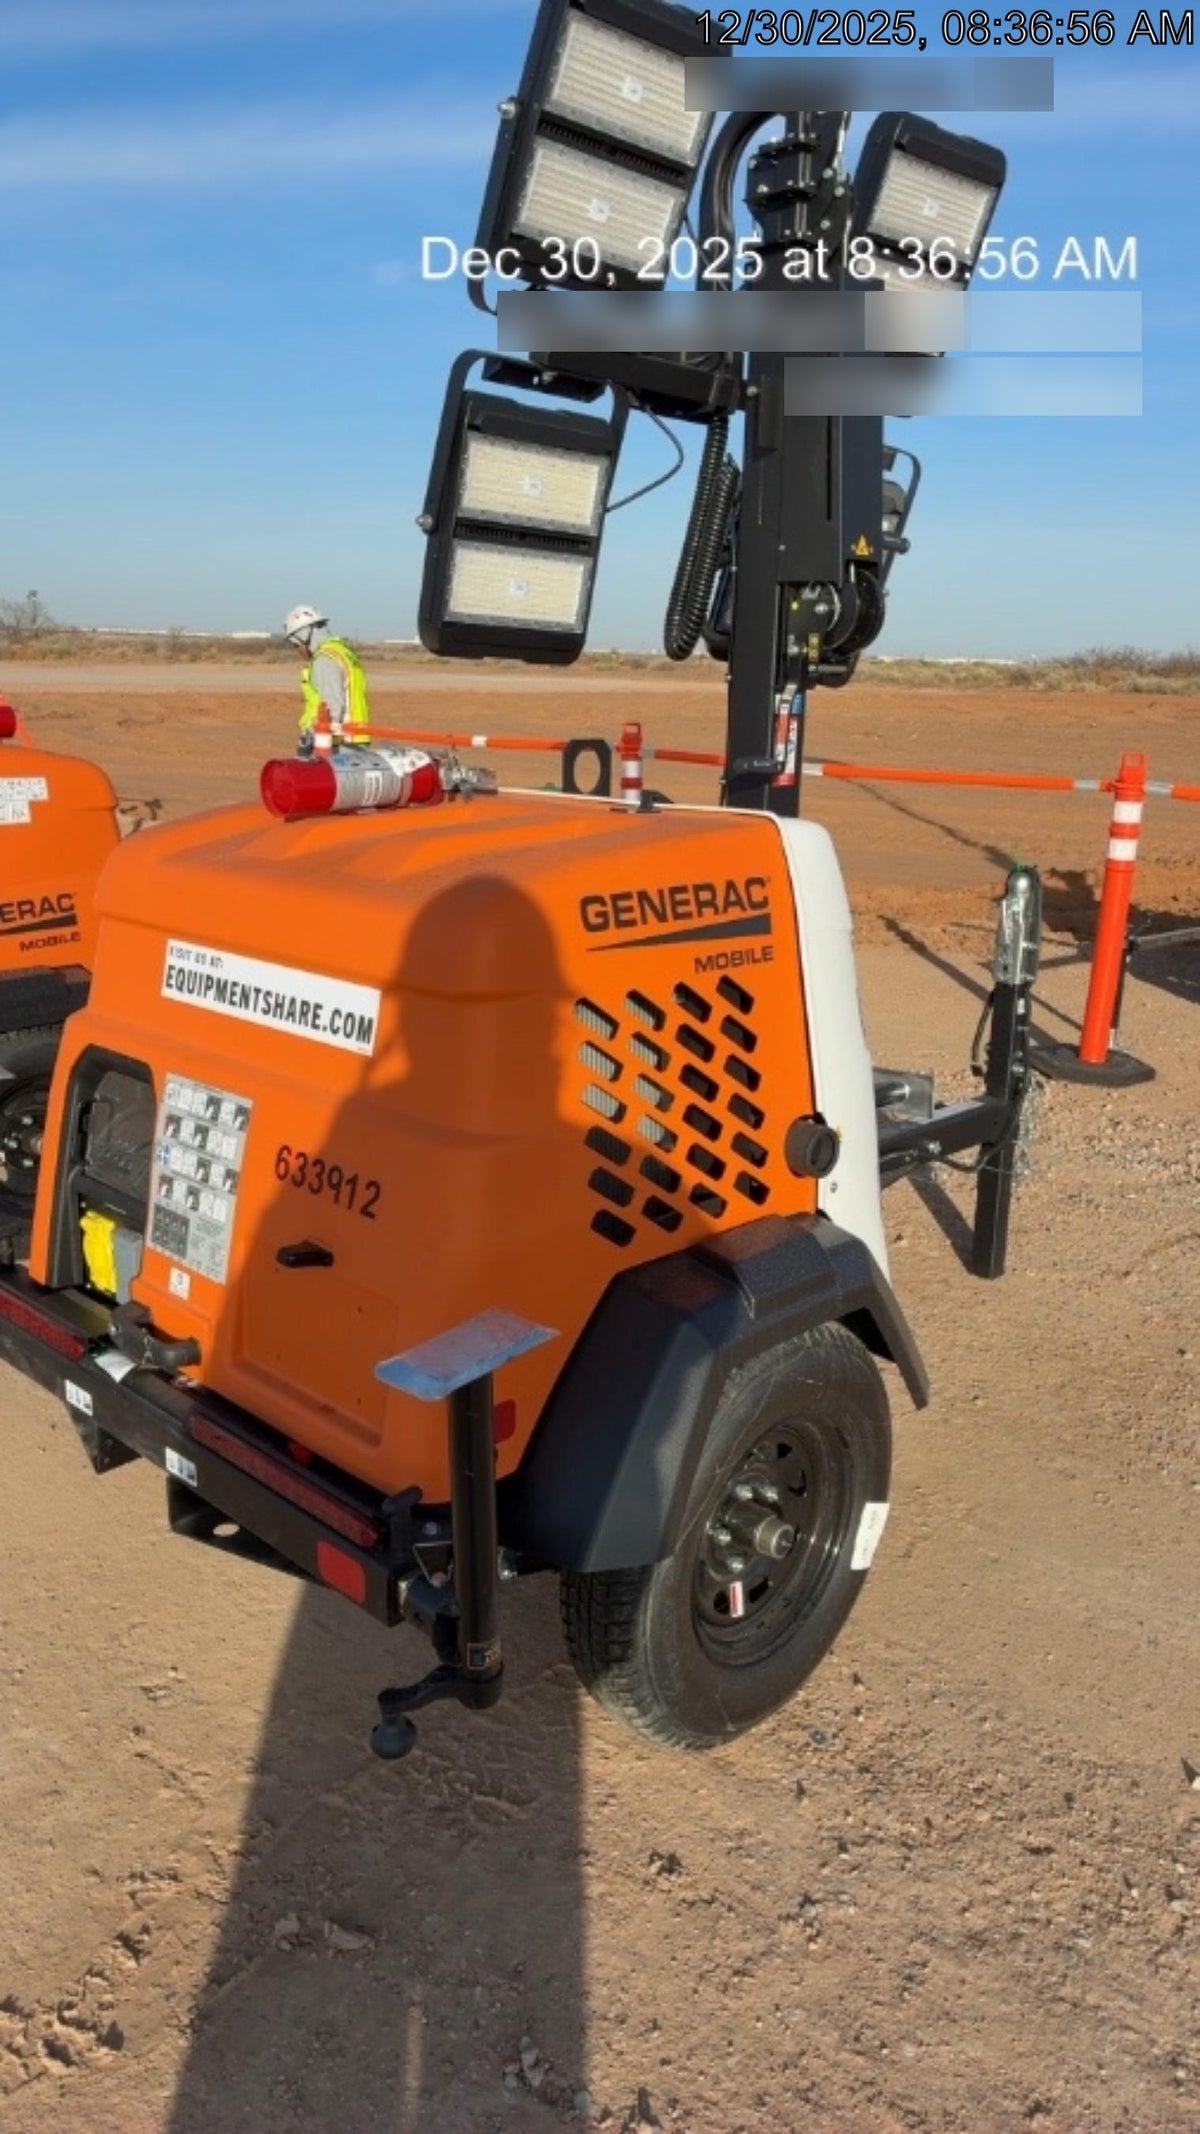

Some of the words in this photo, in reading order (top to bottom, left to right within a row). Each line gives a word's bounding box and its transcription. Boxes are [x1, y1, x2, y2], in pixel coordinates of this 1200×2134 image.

[580, 876, 770, 932] GENERAC
[19, 931, 81, 952] MOBILE
[694, 945, 774, 974] MOBILE
[164, 964, 374, 1045] EQUIPMENTSHARE.COM
[275, 1144, 381, 1220] 633912
